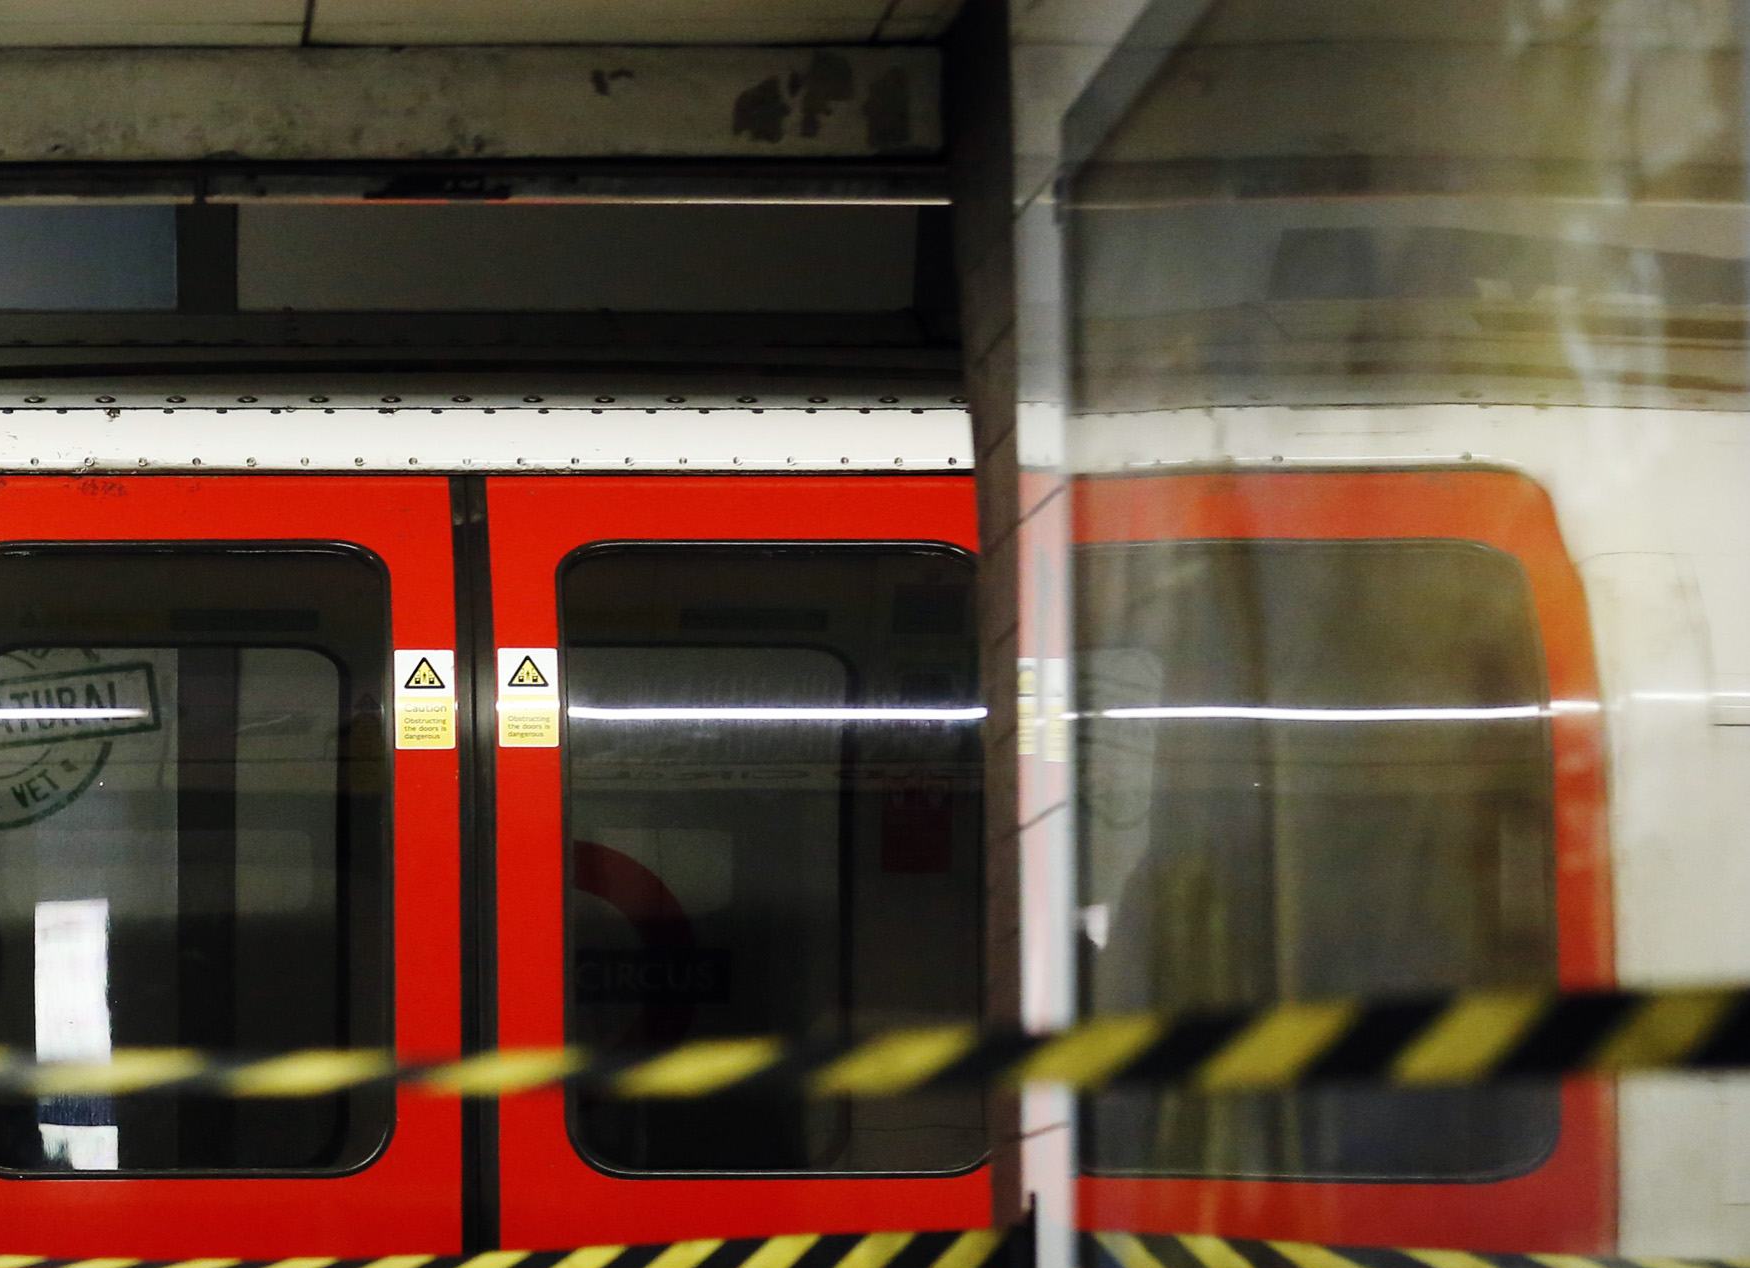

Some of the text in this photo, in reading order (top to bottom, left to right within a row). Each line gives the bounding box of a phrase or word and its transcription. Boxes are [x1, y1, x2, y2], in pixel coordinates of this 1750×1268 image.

[404, 717, 447, 725] Obstructing
[404, 733, 441, 741] dangerous
[507, 731, 544, 739] dangerous
[576, 959, 715, 993] CIRCUS
